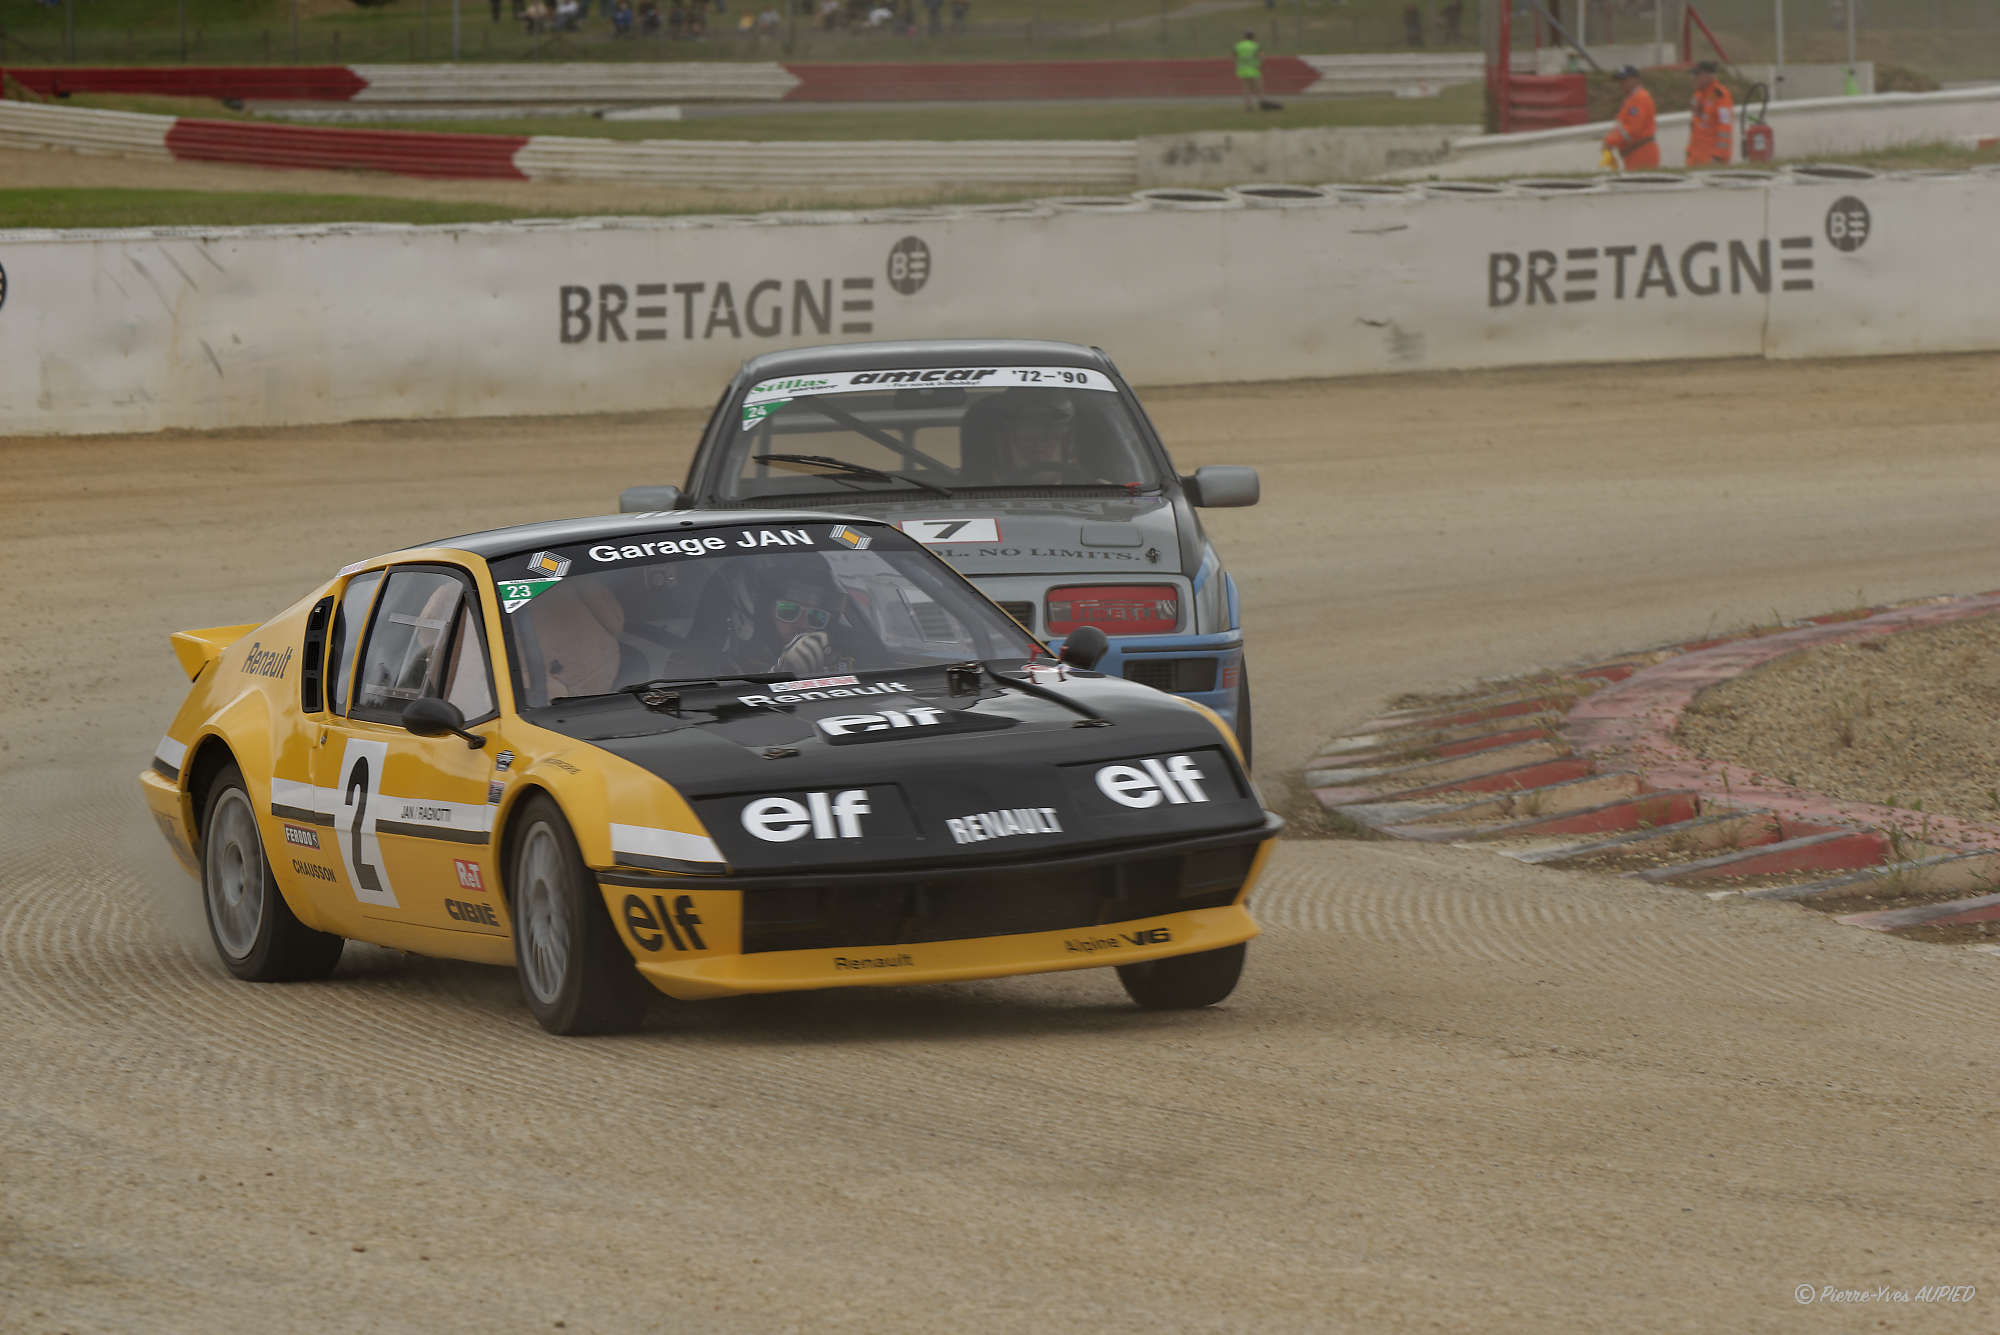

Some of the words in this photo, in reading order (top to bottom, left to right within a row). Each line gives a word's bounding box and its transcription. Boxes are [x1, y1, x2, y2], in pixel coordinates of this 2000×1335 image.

[1488, 236, 1814, 307] BRETAGNE
[559, 277, 874, 344] BRETAGNE
[850, 370, 998, 386] amcar
[922, 520, 973, 539] 7
[588, 536, 727, 562] Garage
[735, 529, 815, 548] JAN
[979, 547, 1021, 557] NO
[1031, 548, 1141, 561] LIMITS.
[507, 584, 533, 598] 23
[240, 641, 293, 679] Renault
[737, 682, 913, 707] Renault
[816, 706, 945, 736] elf
[1095, 755, 1211, 809] elf
[344, 756, 384, 892] 2
[741, 789, 872, 842] elf
[945, 807, 1064, 844] RENAULT
[285, 826, 314, 847] FERODO
[292, 858, 337, 883] CHAUSSON
[624, 894, 707, 952] elf
[834, 953, 915, 971] Renault
